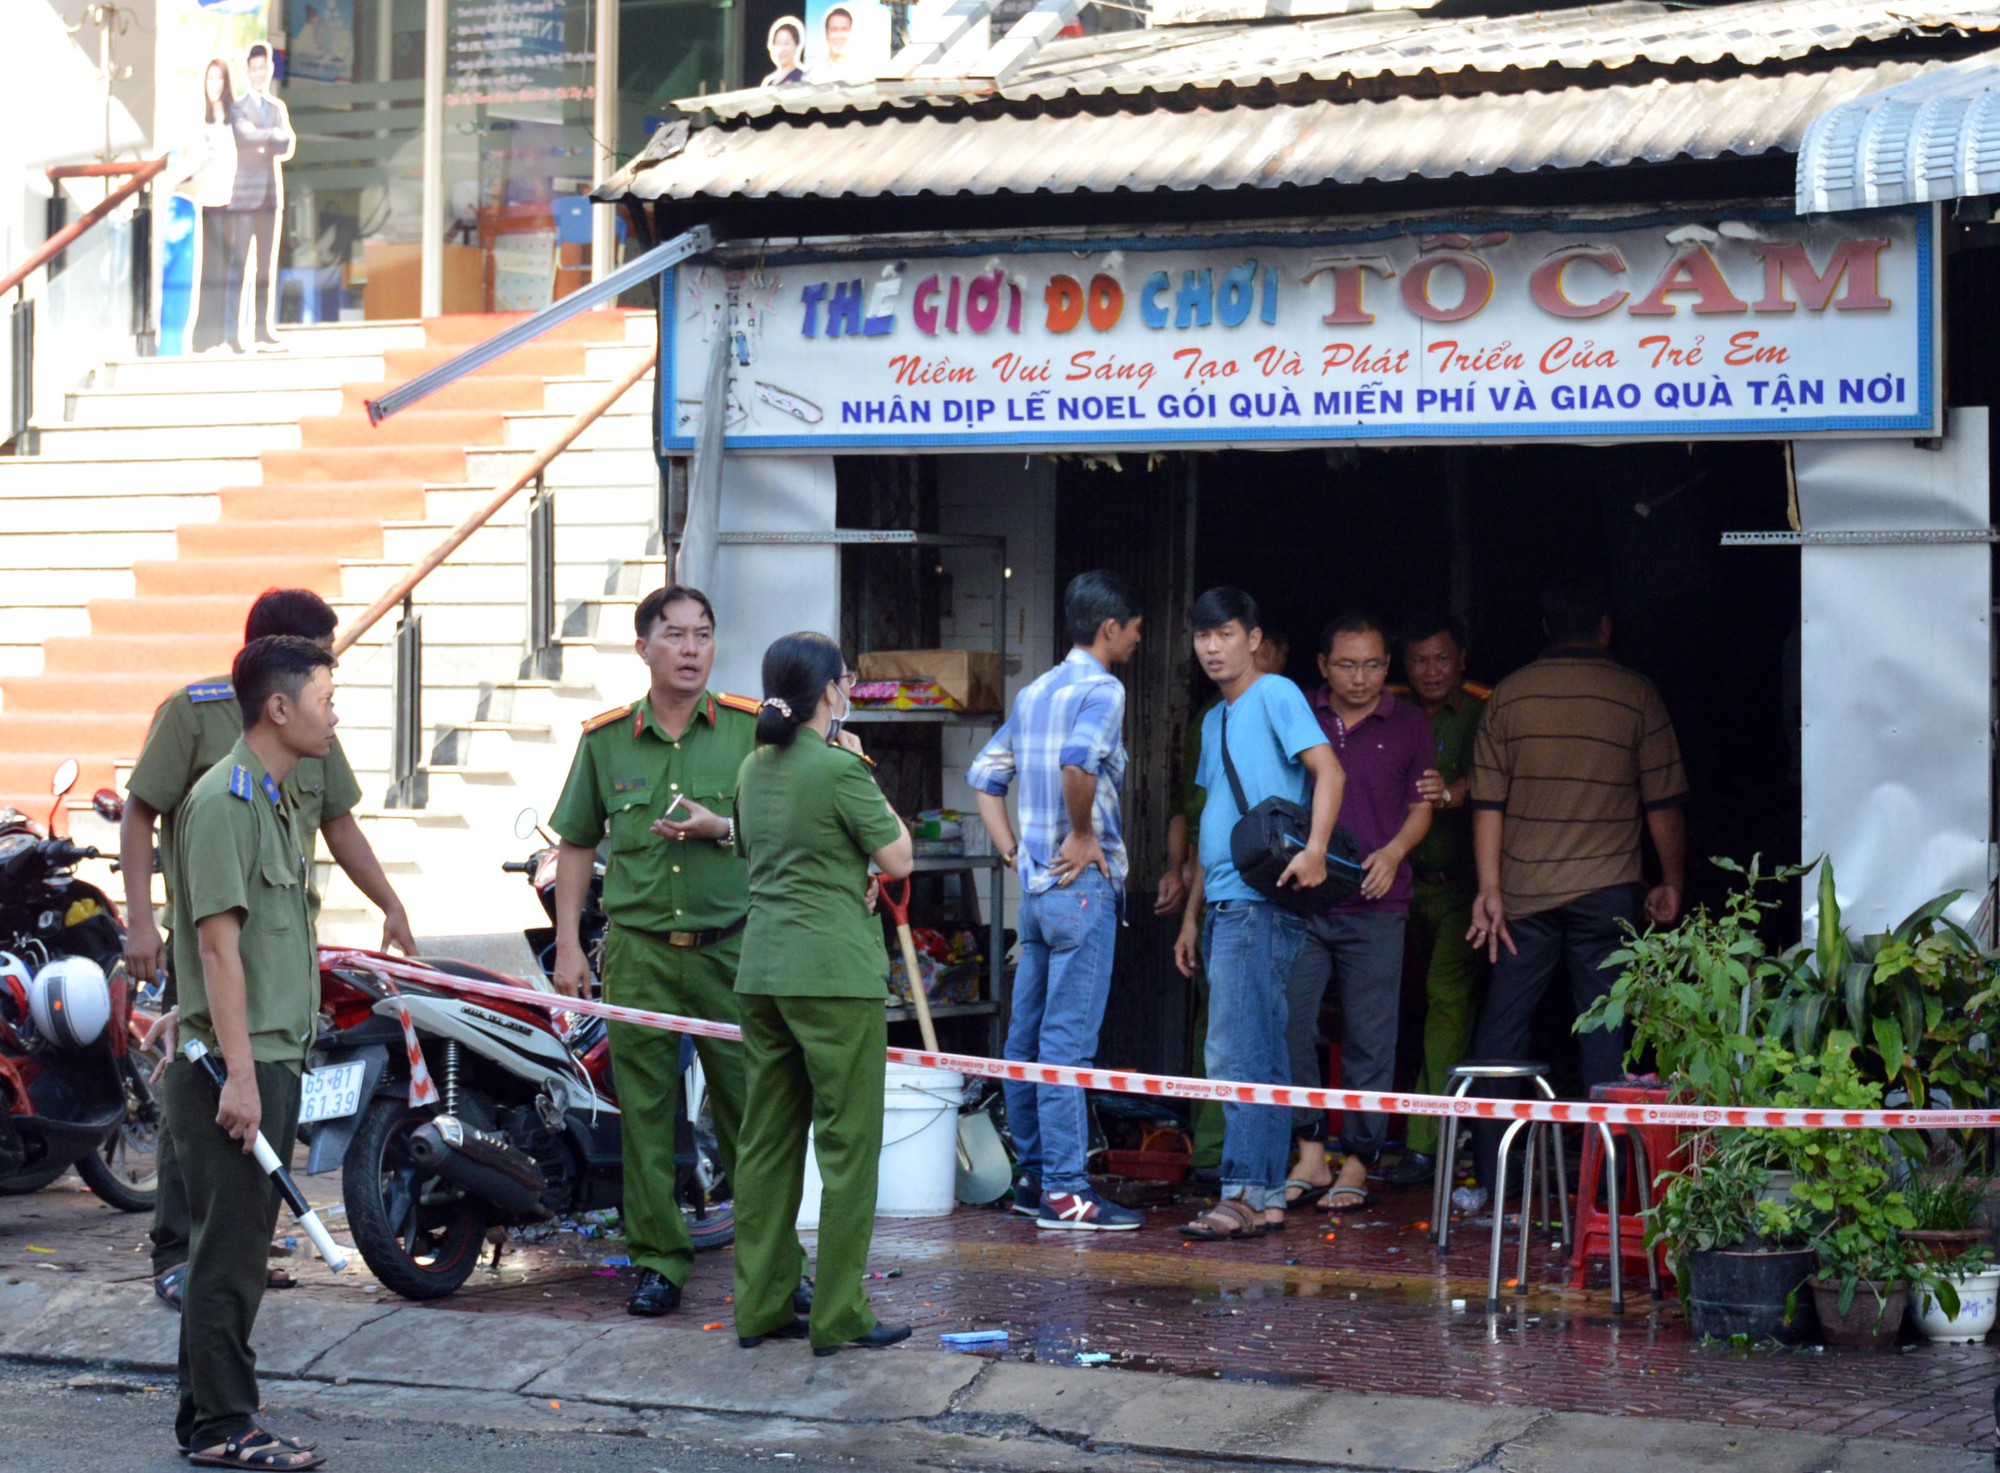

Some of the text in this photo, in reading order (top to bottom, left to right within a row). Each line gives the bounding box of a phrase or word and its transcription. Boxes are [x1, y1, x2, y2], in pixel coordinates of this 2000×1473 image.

[1141, 258, 1278, 329] CHƠI
[1300, 232, 1512, 325] TỐ
[888, 331, 1790, 390] Niềm Vui Sáng Tạo Và Phát Triển Của Trẻ Em
[842, 373, 1905, 429] NHÂN DỊP LỄ NOEL GÓI QUÀ MIỄN PHÍ VÀ GIAO QUÀ TẬN NƠI
[301, 1091, 355, 1119] 61.39
